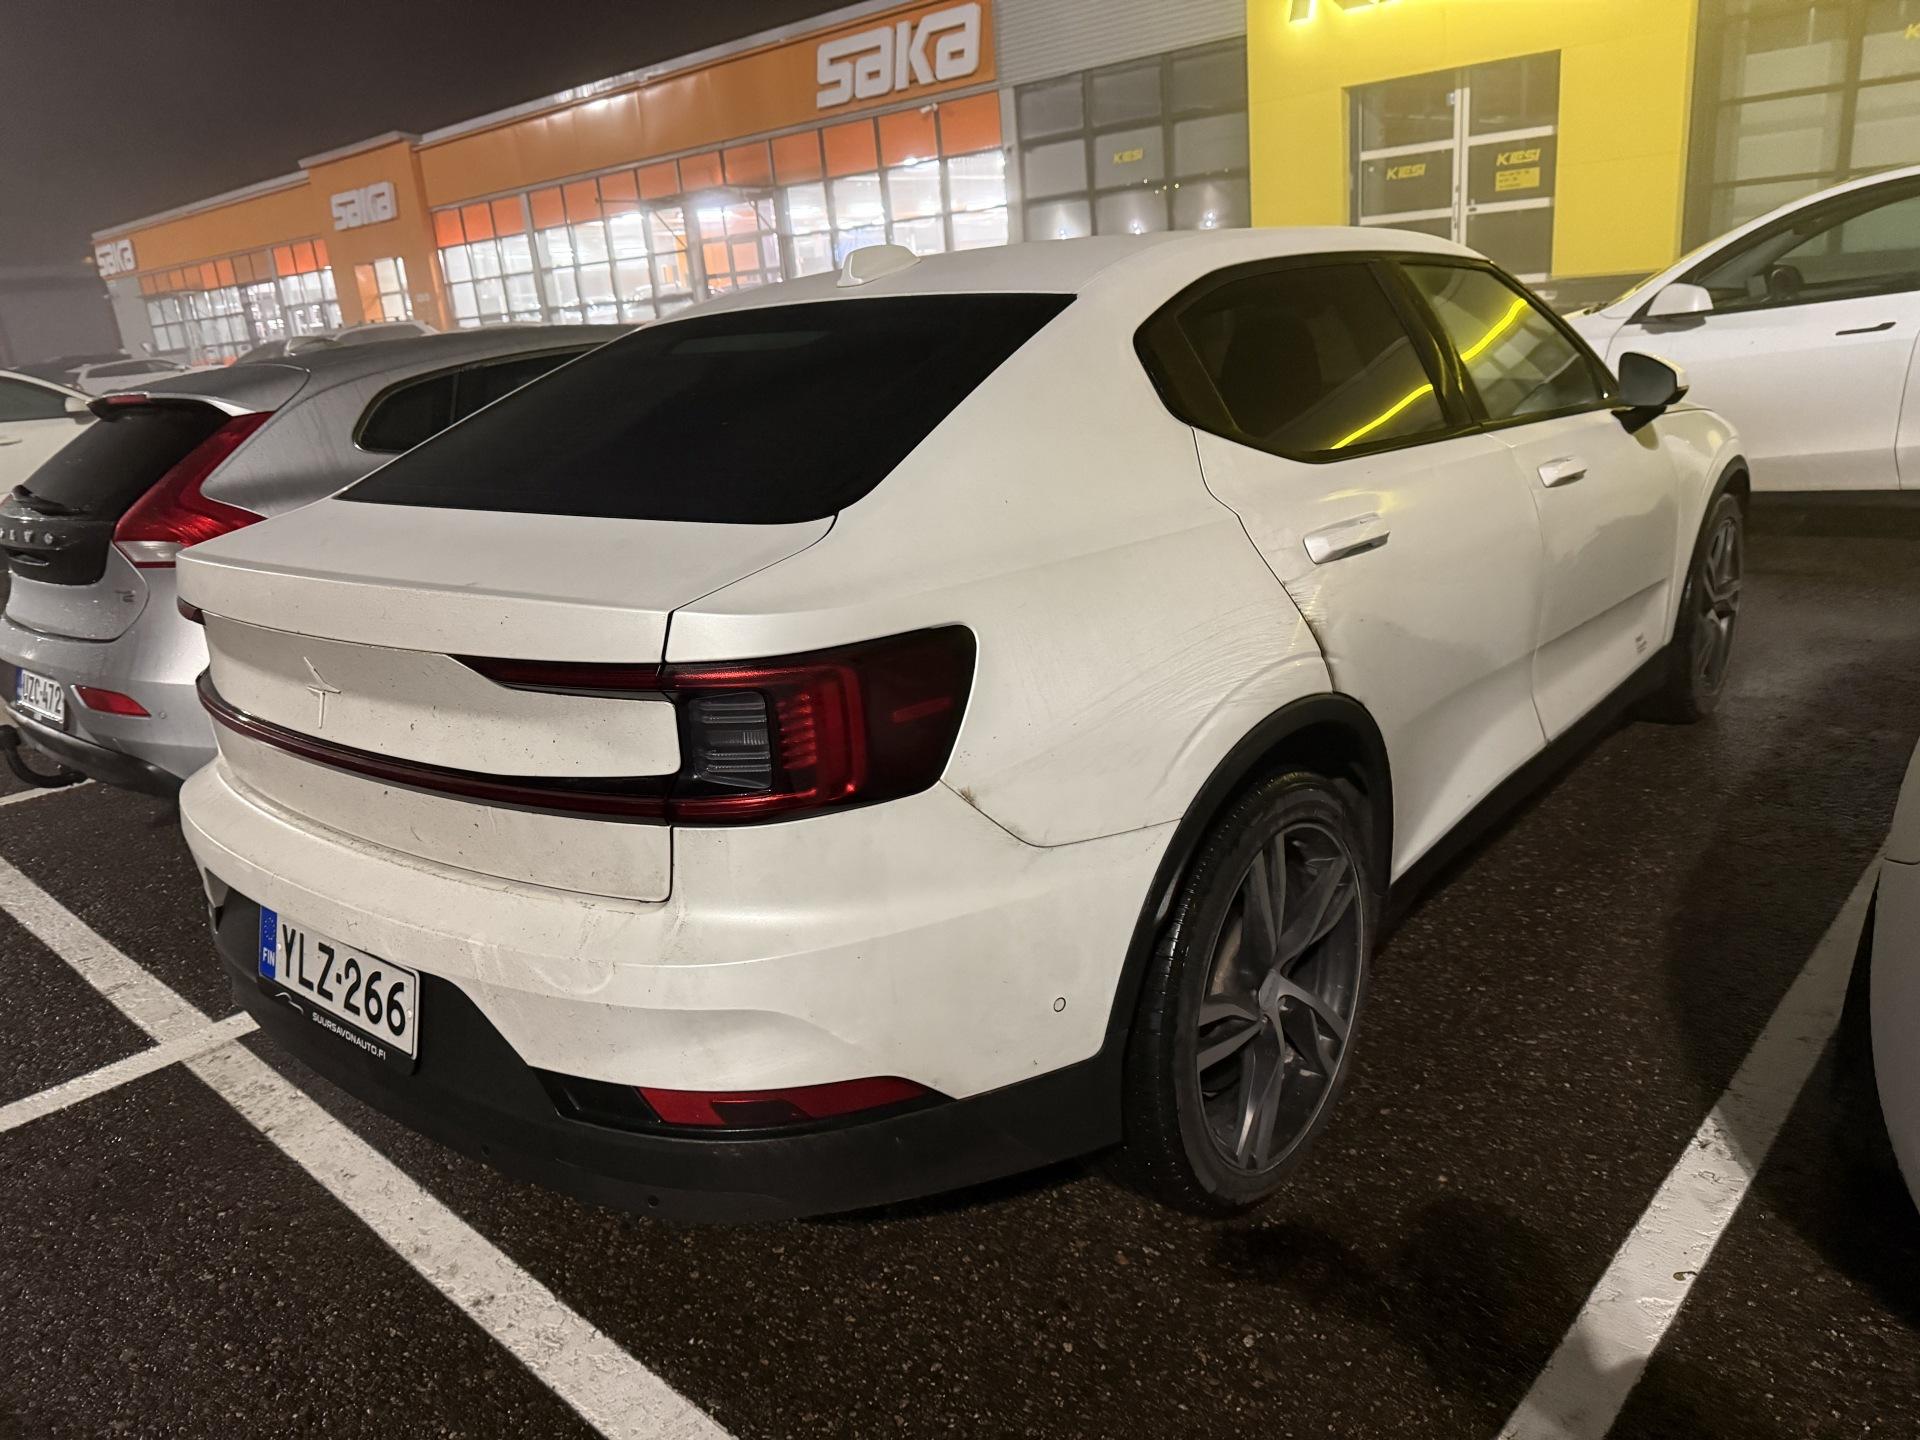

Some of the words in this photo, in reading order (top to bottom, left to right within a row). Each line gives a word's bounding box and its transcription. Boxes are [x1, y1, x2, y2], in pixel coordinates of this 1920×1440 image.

[262, 947, 275, 966] FIN
[282, 923, 406, 1037] YLZ-266
[312, 1012, 387, 1060] SUURSAVONAUTO.FI
